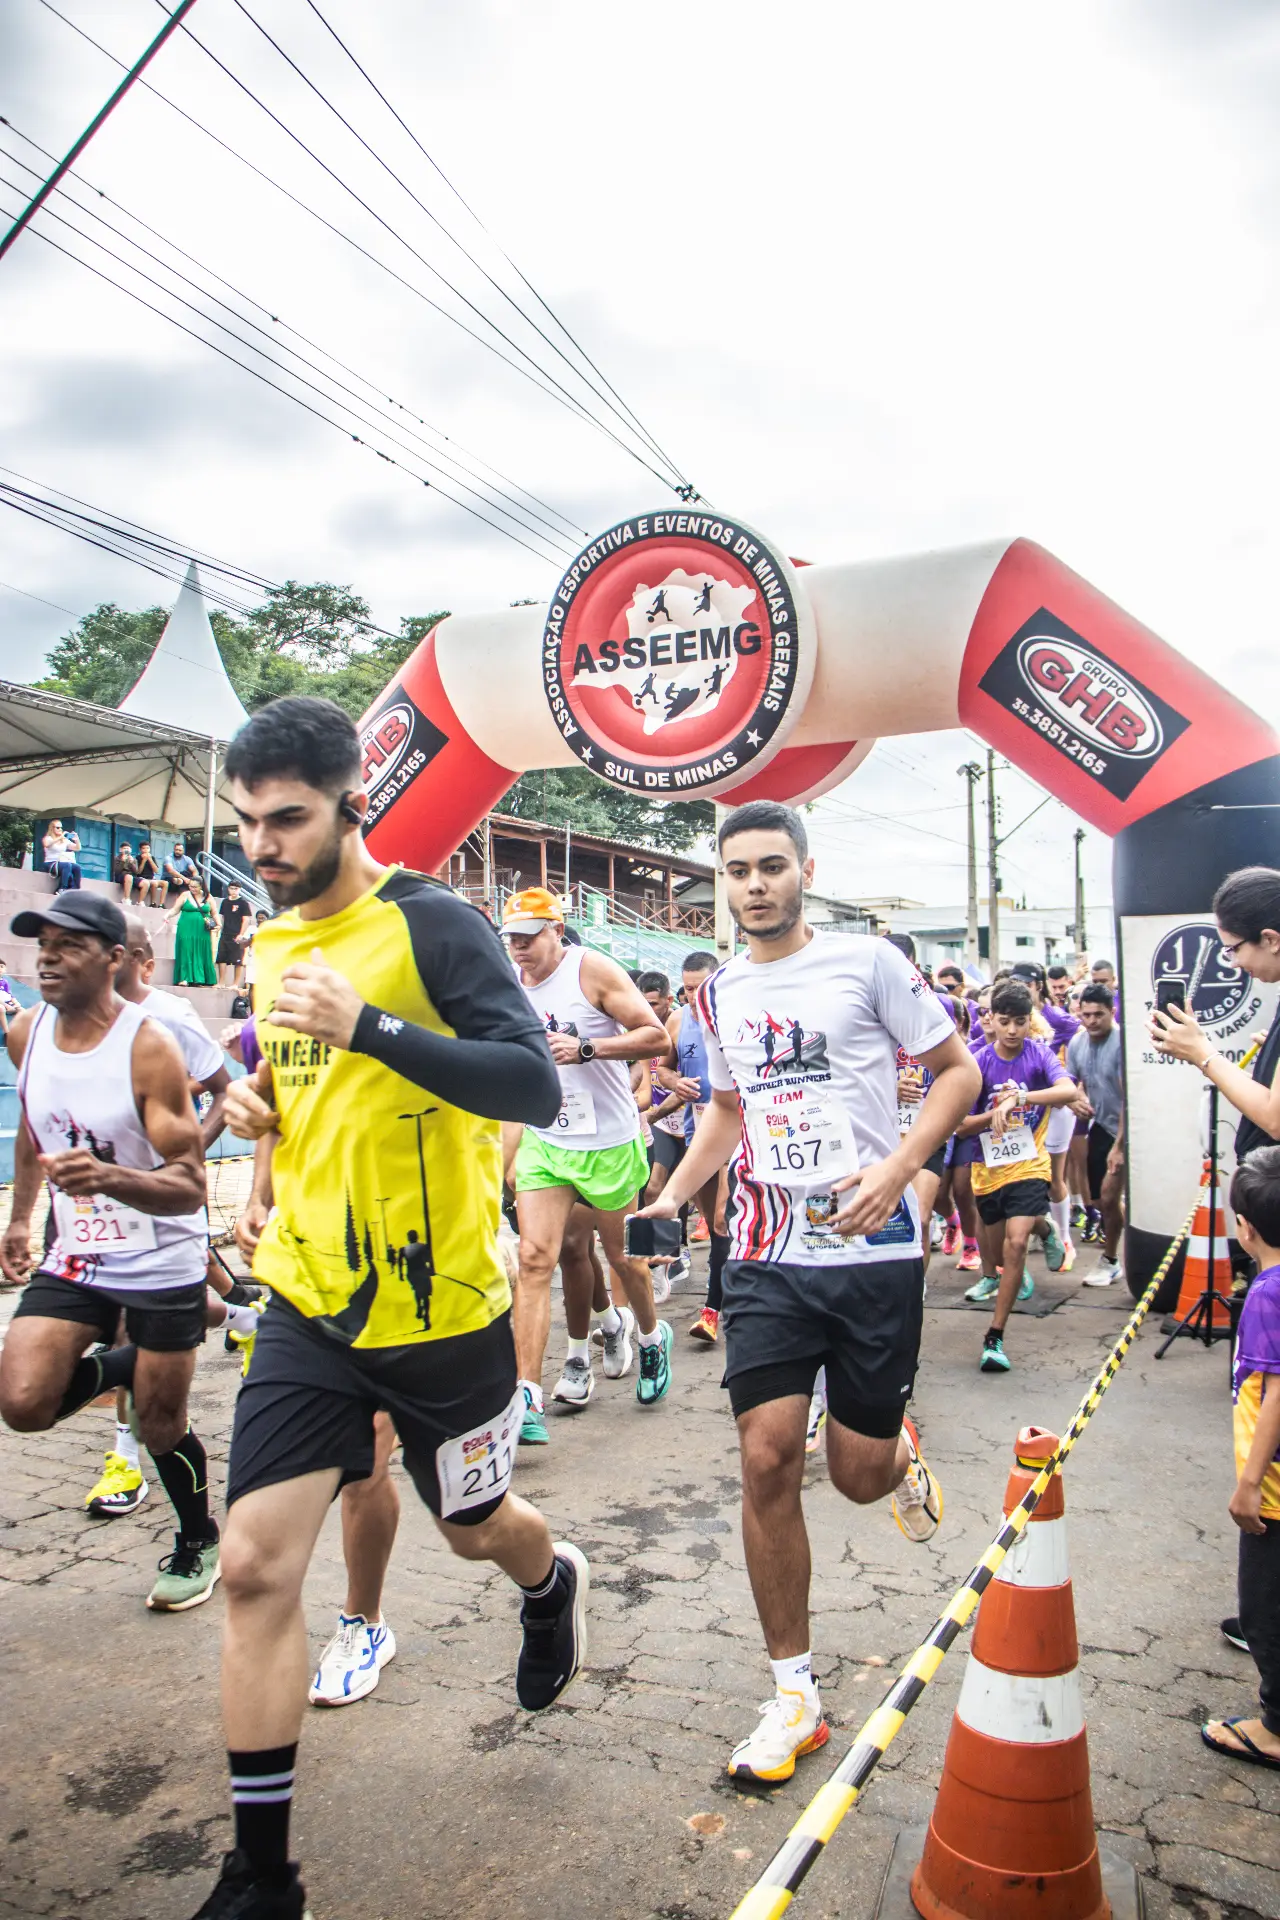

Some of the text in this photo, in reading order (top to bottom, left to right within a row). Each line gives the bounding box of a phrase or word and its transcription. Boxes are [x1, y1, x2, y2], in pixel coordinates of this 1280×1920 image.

[545, 515, 791, 739] ASSOCIAÇÃO ESPORTIVA E EVENTOS DE MINAS GERAIS
[573, 622, 762, 675] ASSEEMG
[1081, 660, 1127, 698] GRUPO
[1027, 648, 1147, 751] GHB
[361, 715, 408, 784] HB
[1012, 697, 1107, 776] 35.3851.2165
[604, 751, 738, 788] SUL DE MINAS
[1194, 987, 1242, 1021] FUSOS
[1215, 997, 1262, 1039] VAREJO
[745, 1073, 832, 1093] BROTHER RUNNERS
[773, 1090, 803, 1104] TEAM
[771, 1139, 821, 1170] 167
[991, 1142, 1020, 1160] 248
[74, 1218, 127, 1242] 321
[462, 1445, 511, 1497] 211
